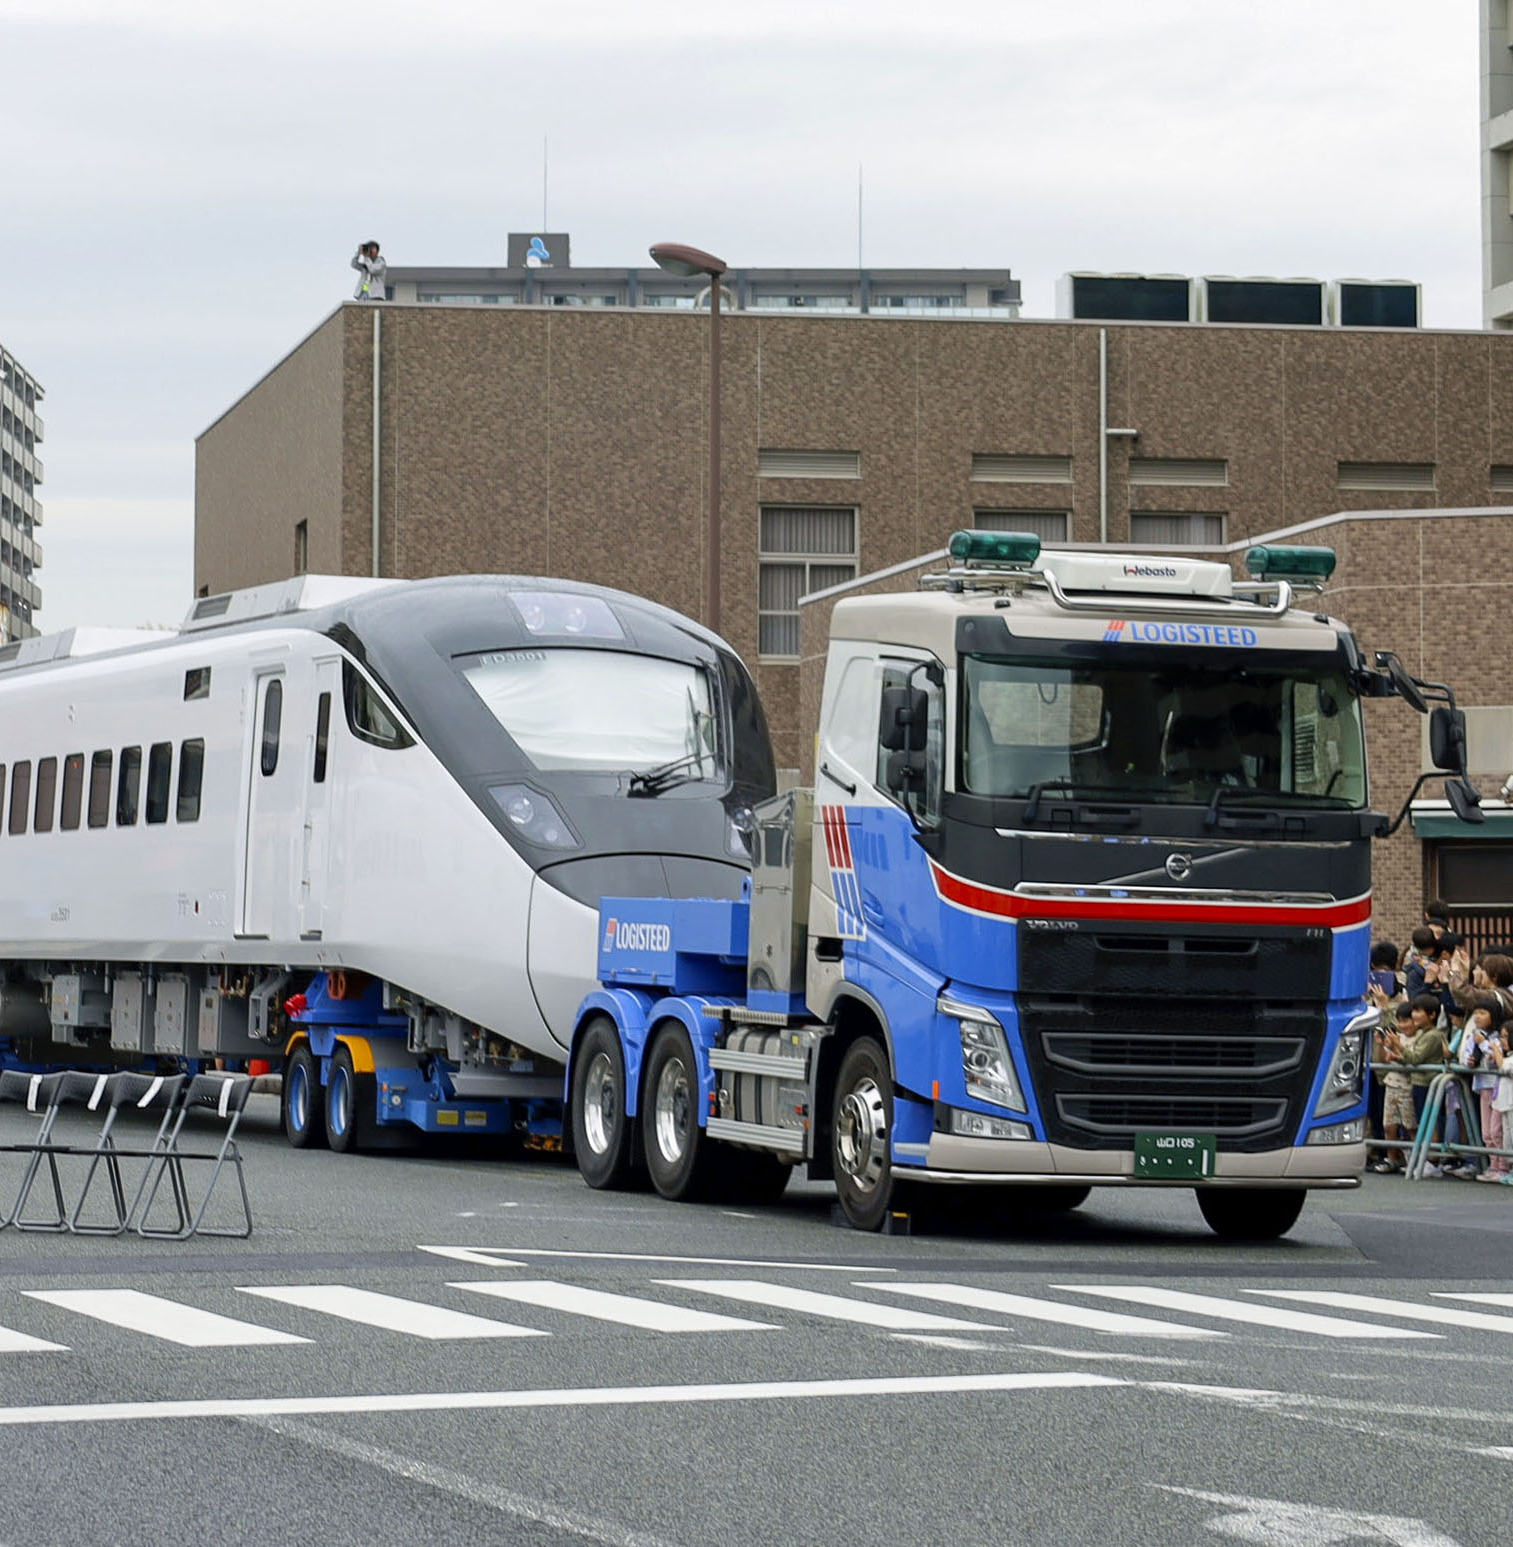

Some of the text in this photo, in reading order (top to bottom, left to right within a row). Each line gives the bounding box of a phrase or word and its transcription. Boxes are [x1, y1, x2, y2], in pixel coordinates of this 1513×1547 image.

[1123, 564, 1177, 577] Webasto
[1130, 622, 1258, 647] LOGISTEED
[1025, 919, 1080, 930] VOLVO
[615, 921, 671, 952] LOGISTEED
